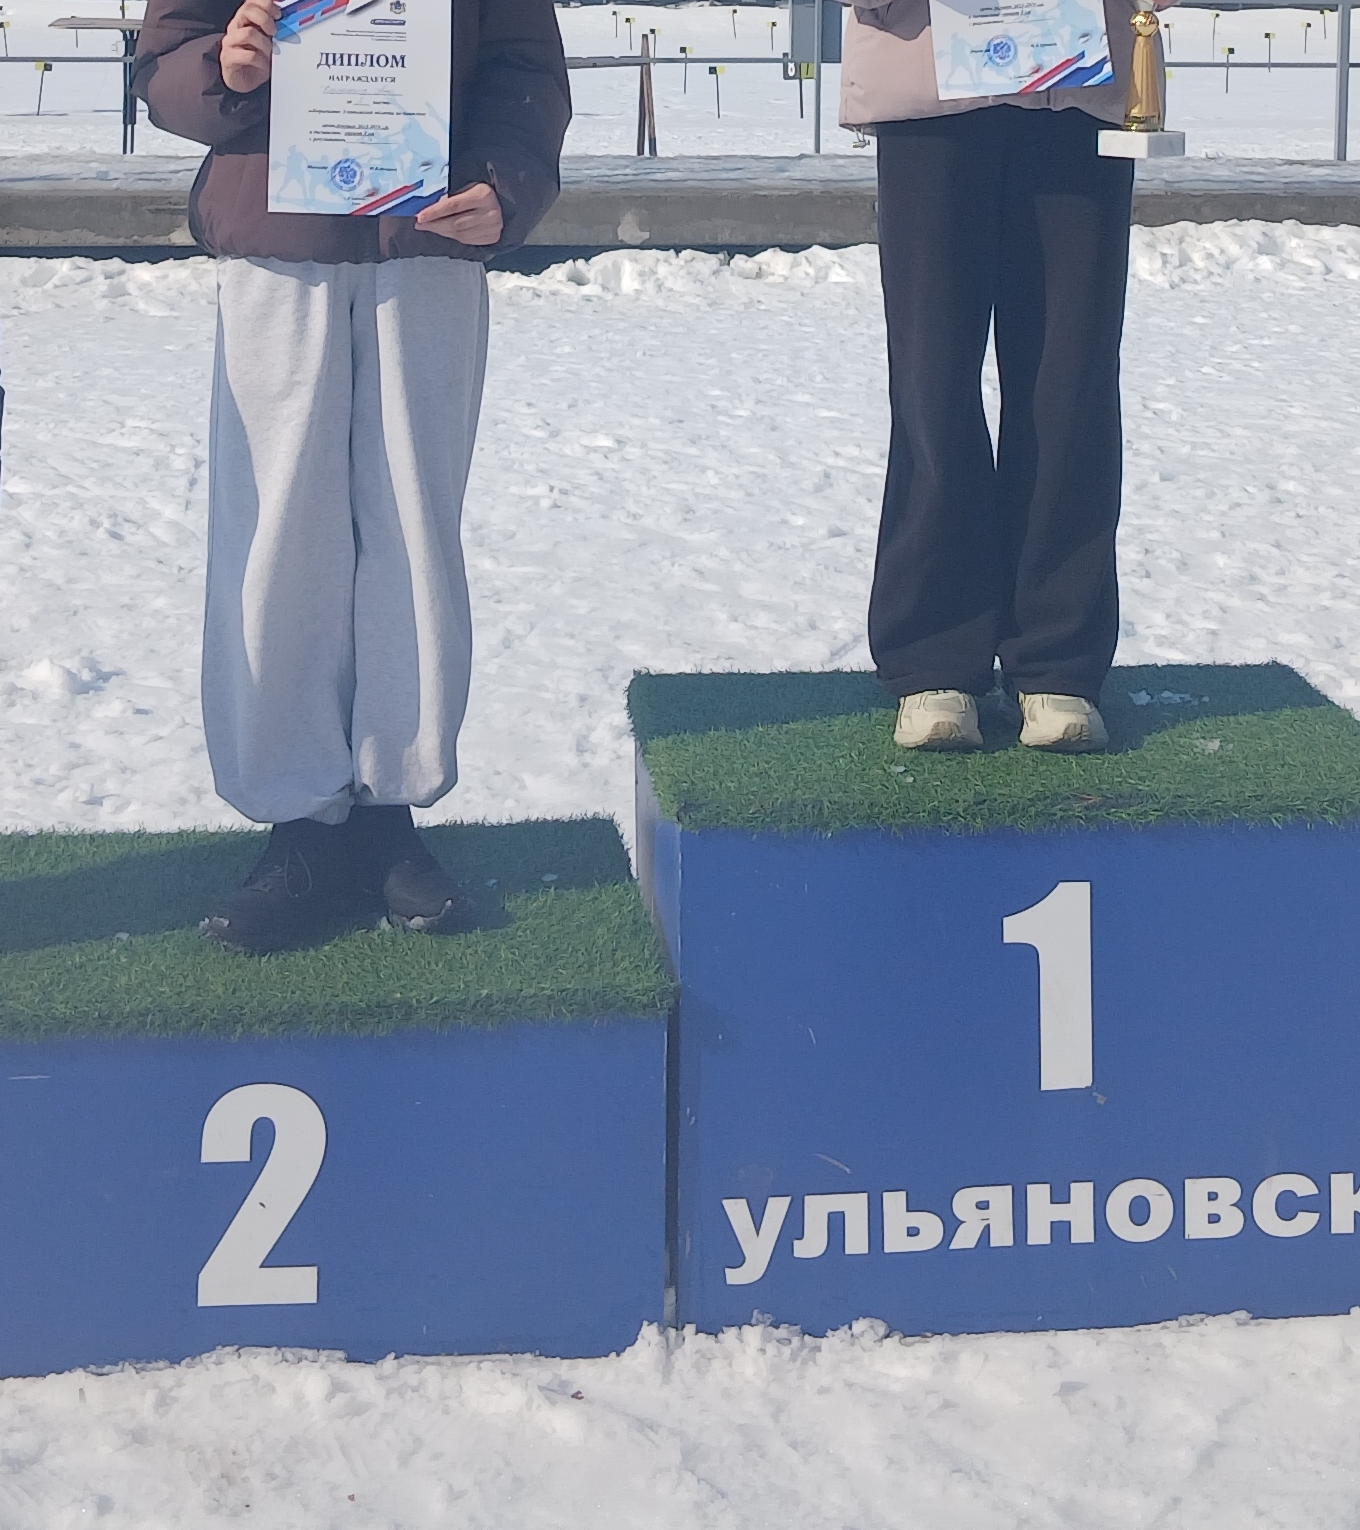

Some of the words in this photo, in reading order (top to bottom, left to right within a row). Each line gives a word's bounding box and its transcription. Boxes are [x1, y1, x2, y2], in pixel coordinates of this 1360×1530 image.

[316, 52, 407, 69] ДИПЛОМ
[1002, 880, 1094, 1091] 1
[197, 1082, 328, 1307] 2
